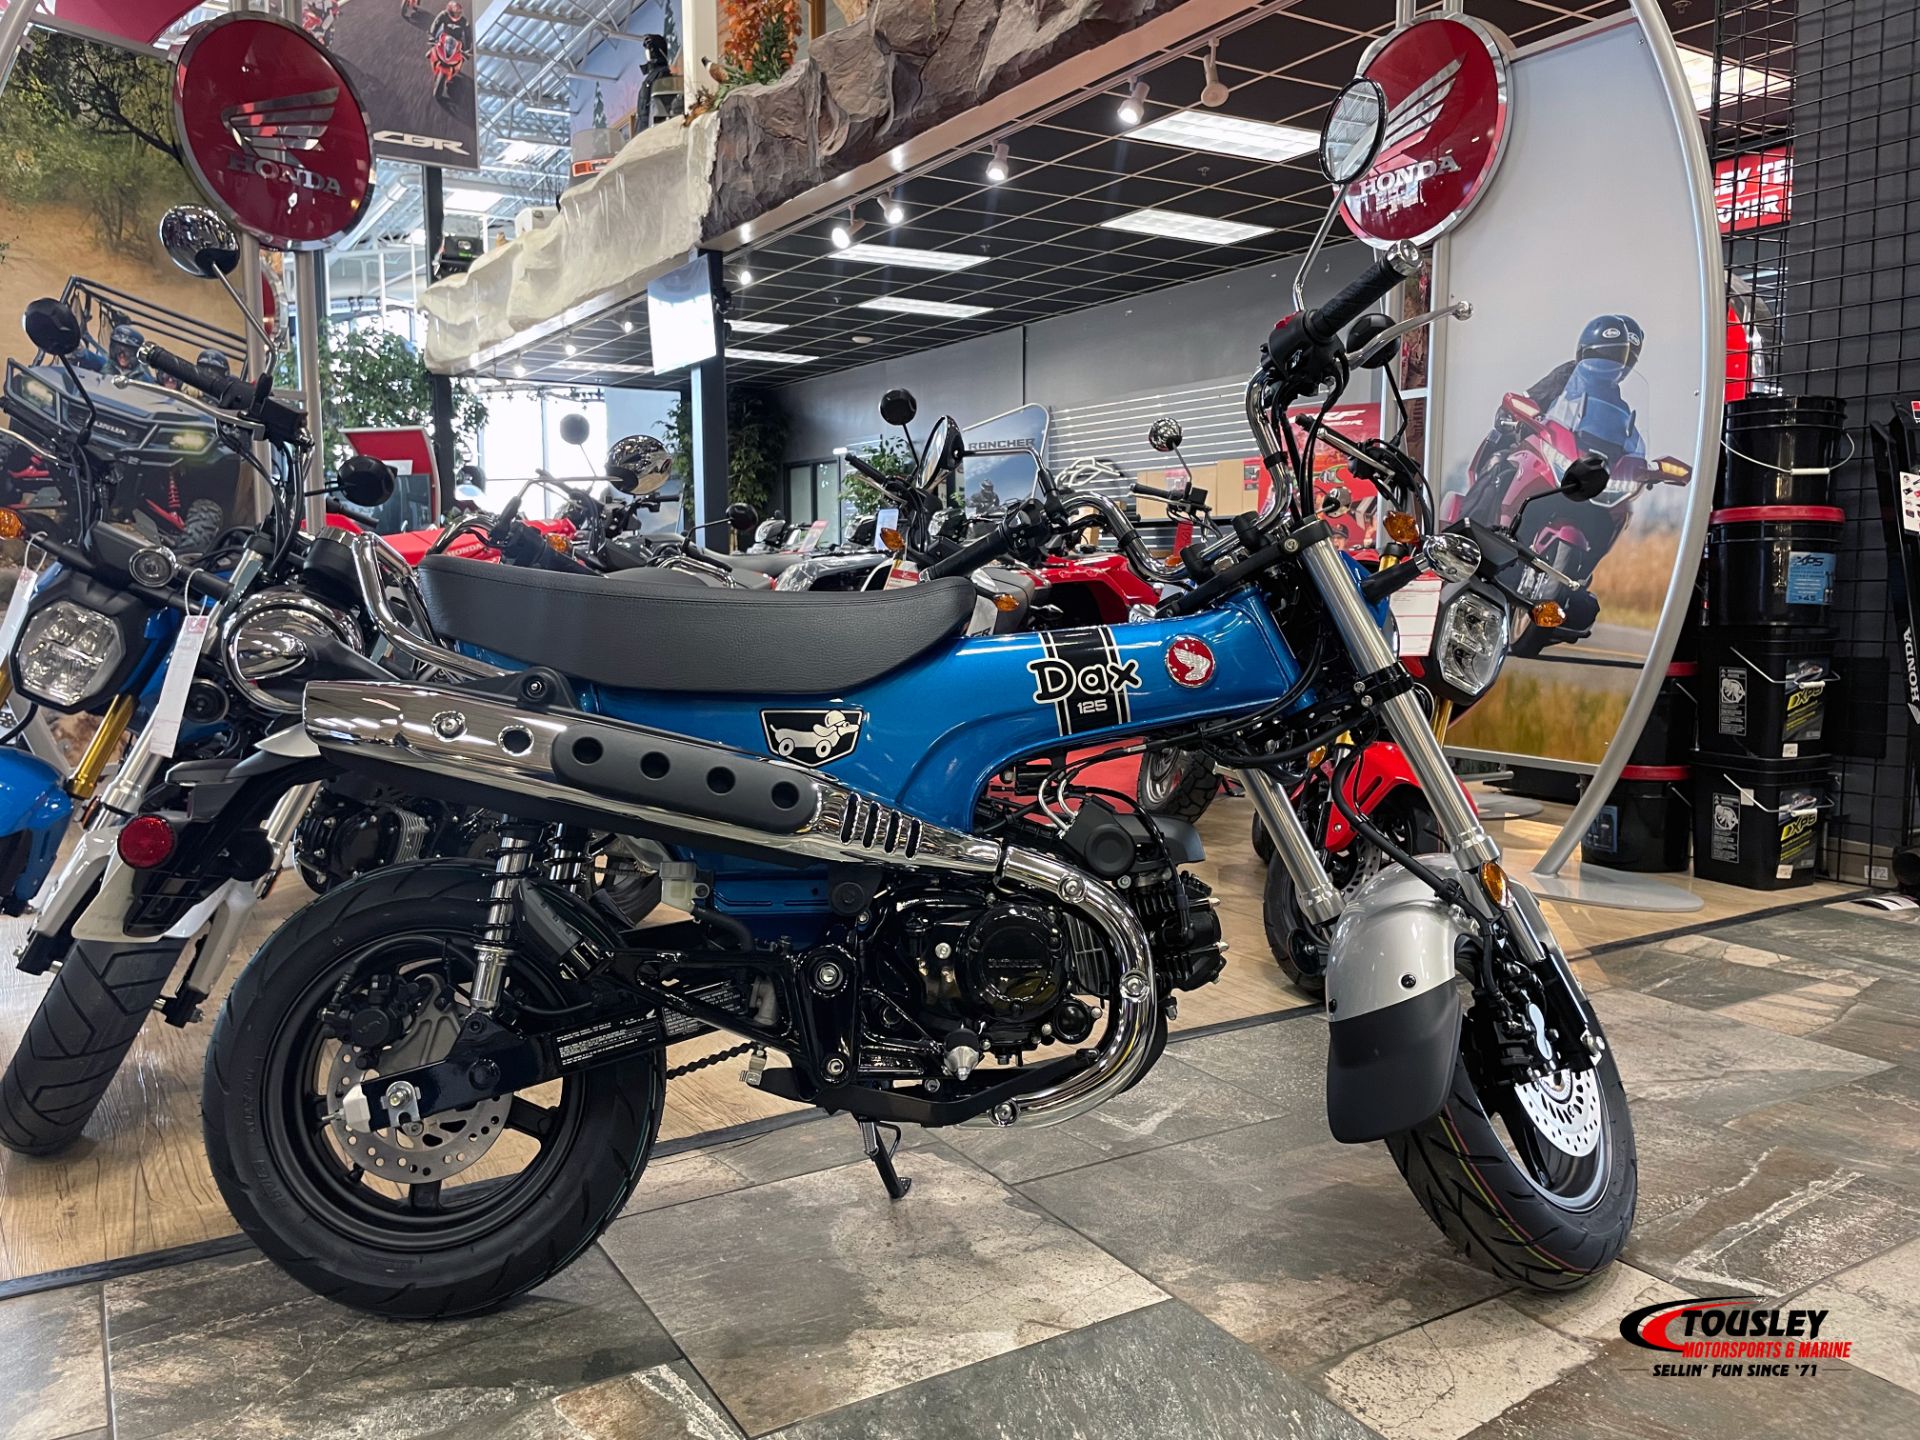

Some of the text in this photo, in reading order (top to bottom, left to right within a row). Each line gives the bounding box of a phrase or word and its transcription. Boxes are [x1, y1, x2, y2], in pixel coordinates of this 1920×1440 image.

[373, 130, 470, 156] CBR
[227, 152, 342, 196] HONDA
[1359, 155, 1462, 197] HONDA
[968, 438, 1036, 451] RANCHER
[1026, 658, 1143, 704] Dax
[1903, 626, 1920, 703] HONDA
[1077, 699, 1109, 715] 125
